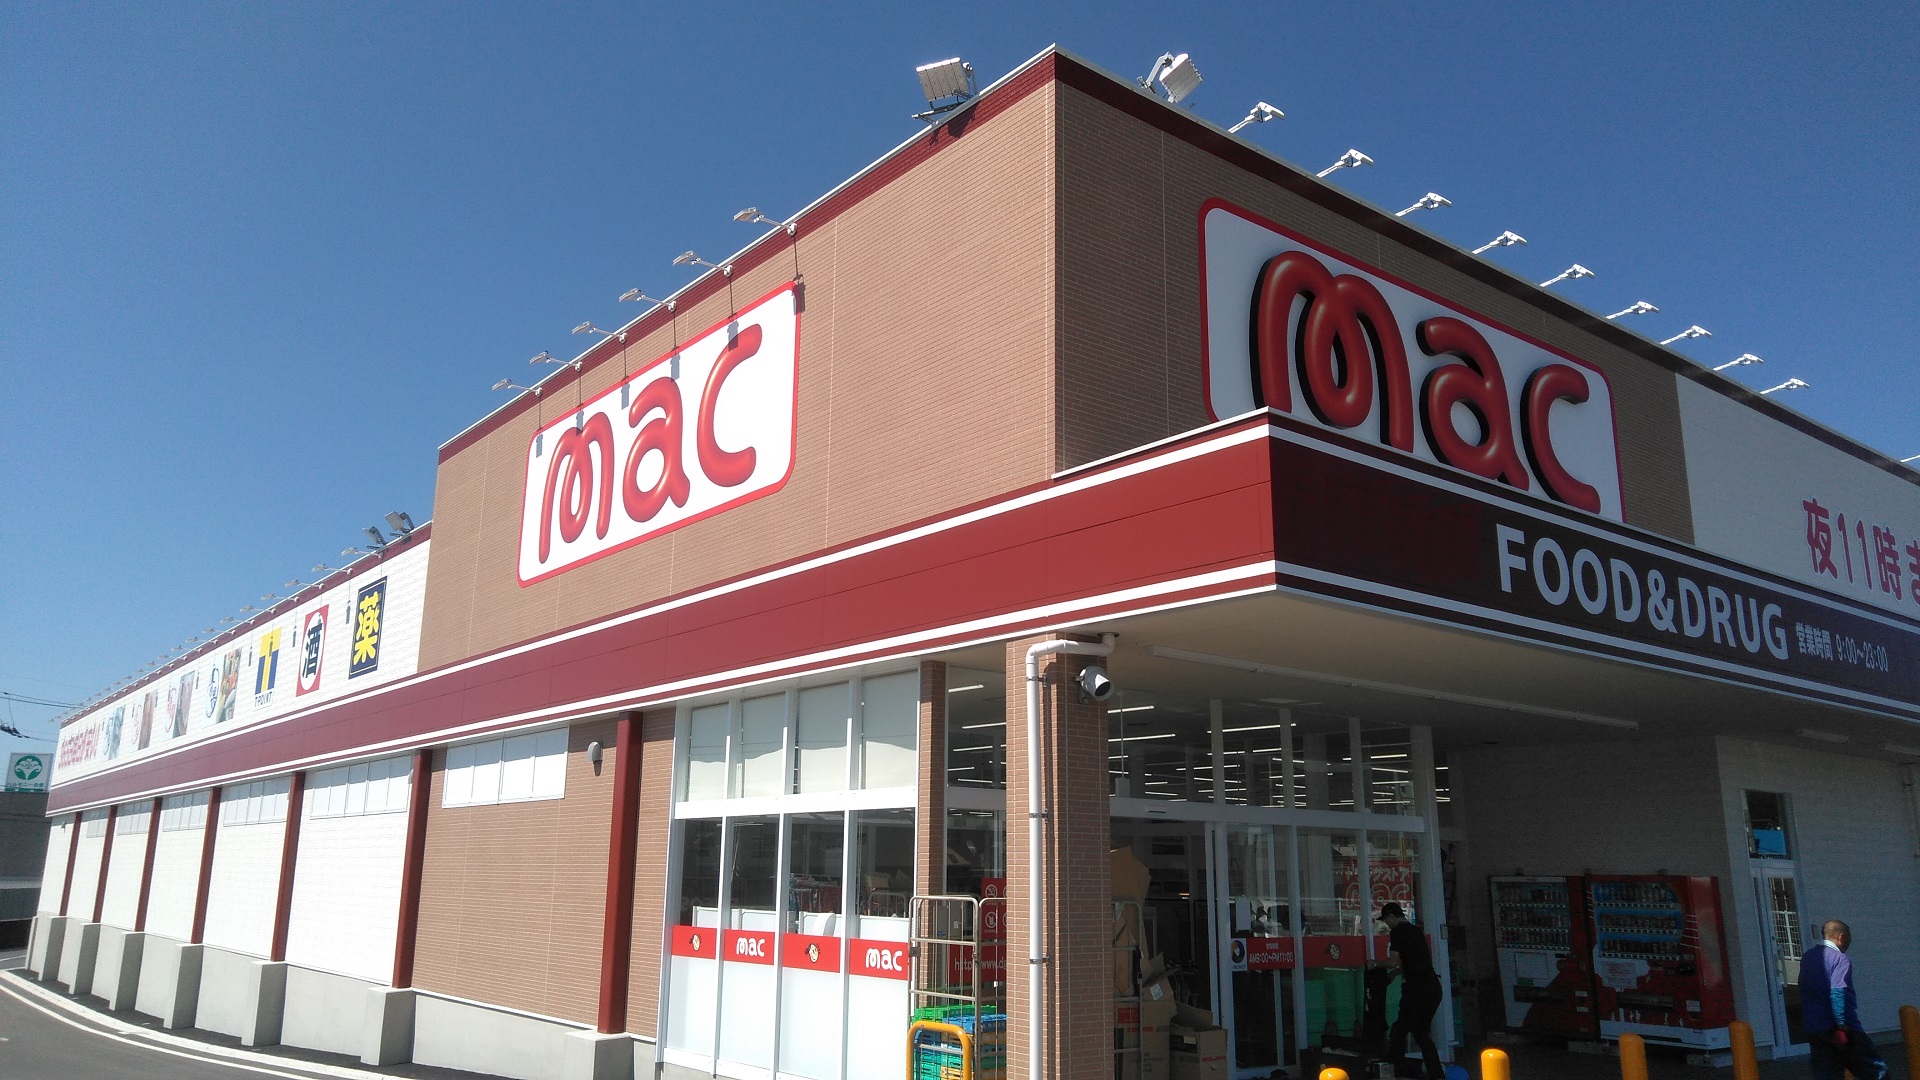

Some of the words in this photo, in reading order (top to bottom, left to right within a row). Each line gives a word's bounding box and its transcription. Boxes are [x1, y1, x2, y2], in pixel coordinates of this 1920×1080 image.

[1251, 251, 1601, 514] mac
[539, 323, 762, 564] mac
[1496, 523, 1789, 661] FOOD&DRUG
[302, 621, 324, 679] 酒
[353, 591, 380, 665] 薬
[1796, 622, 1833, 661] 営業時間
[736, 937, 766, 958] mac
[865, 947, 904, 972] mac
